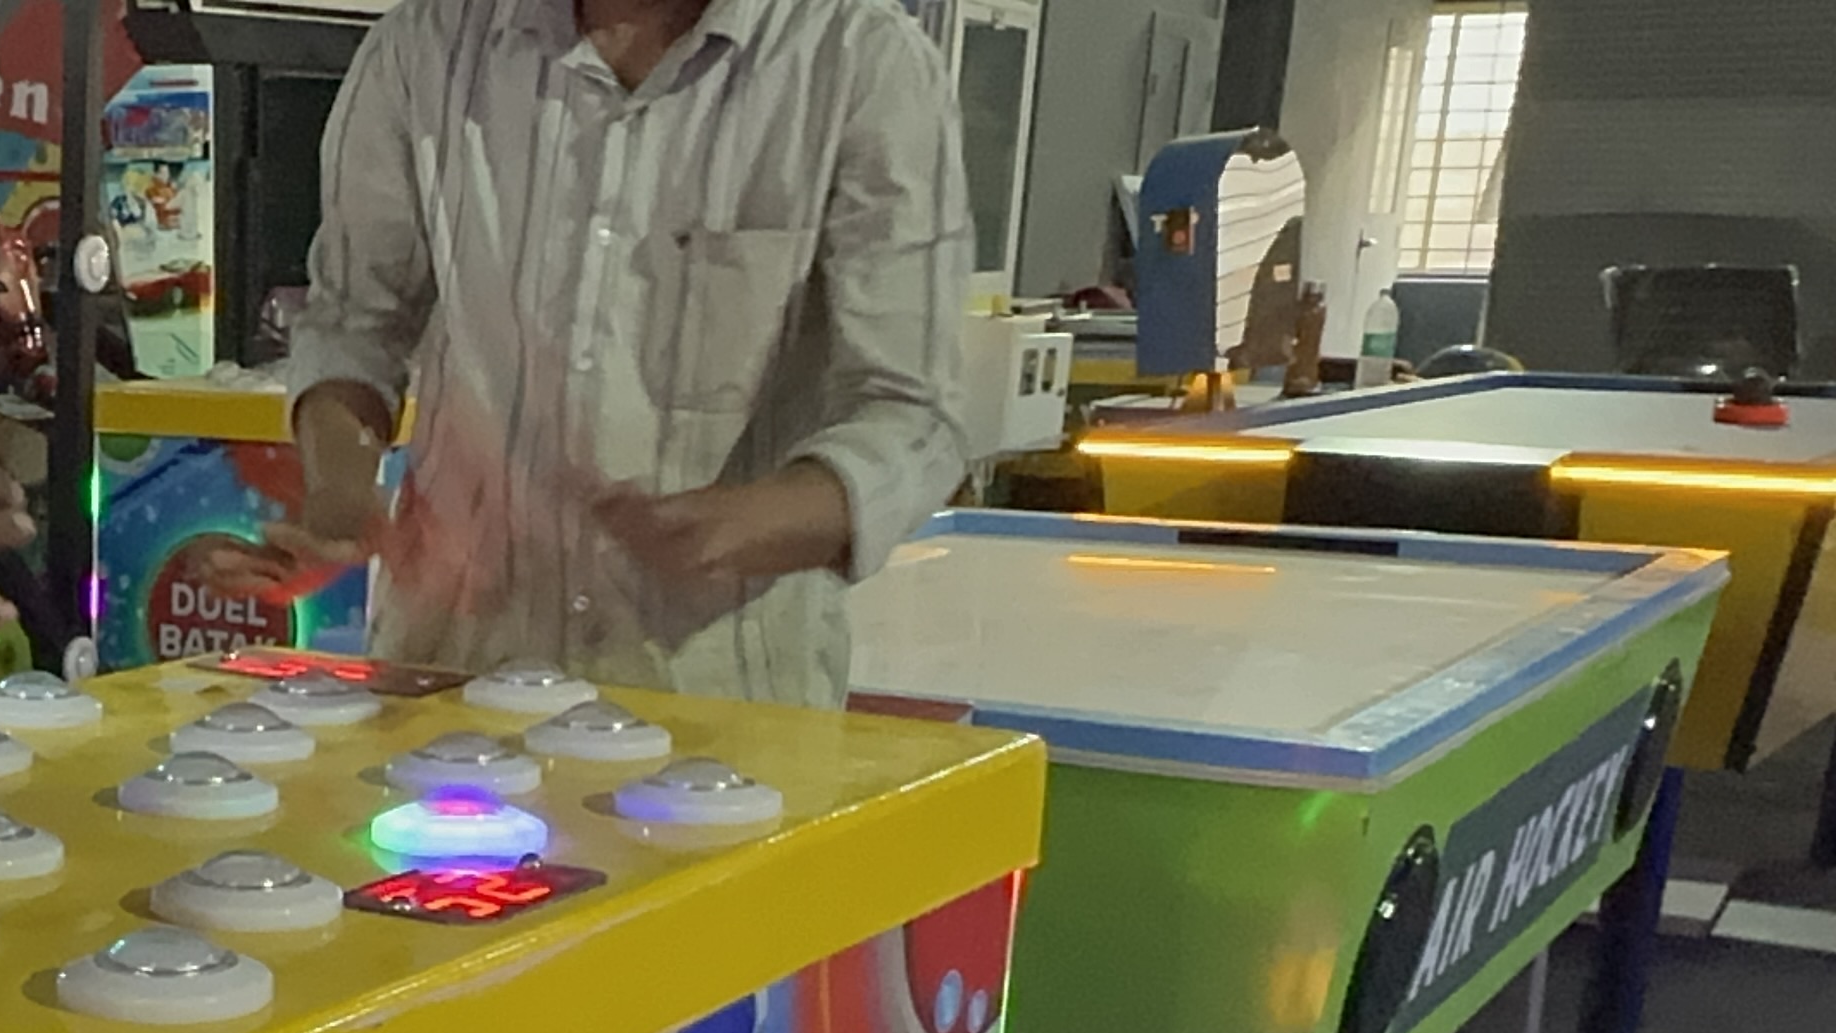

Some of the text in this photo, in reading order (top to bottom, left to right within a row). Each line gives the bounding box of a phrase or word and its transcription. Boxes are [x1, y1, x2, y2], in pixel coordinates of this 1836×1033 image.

[171, 582, 268, 626] DUEL
[1407, 744, 1628, 1001] AIR HOCKEY
